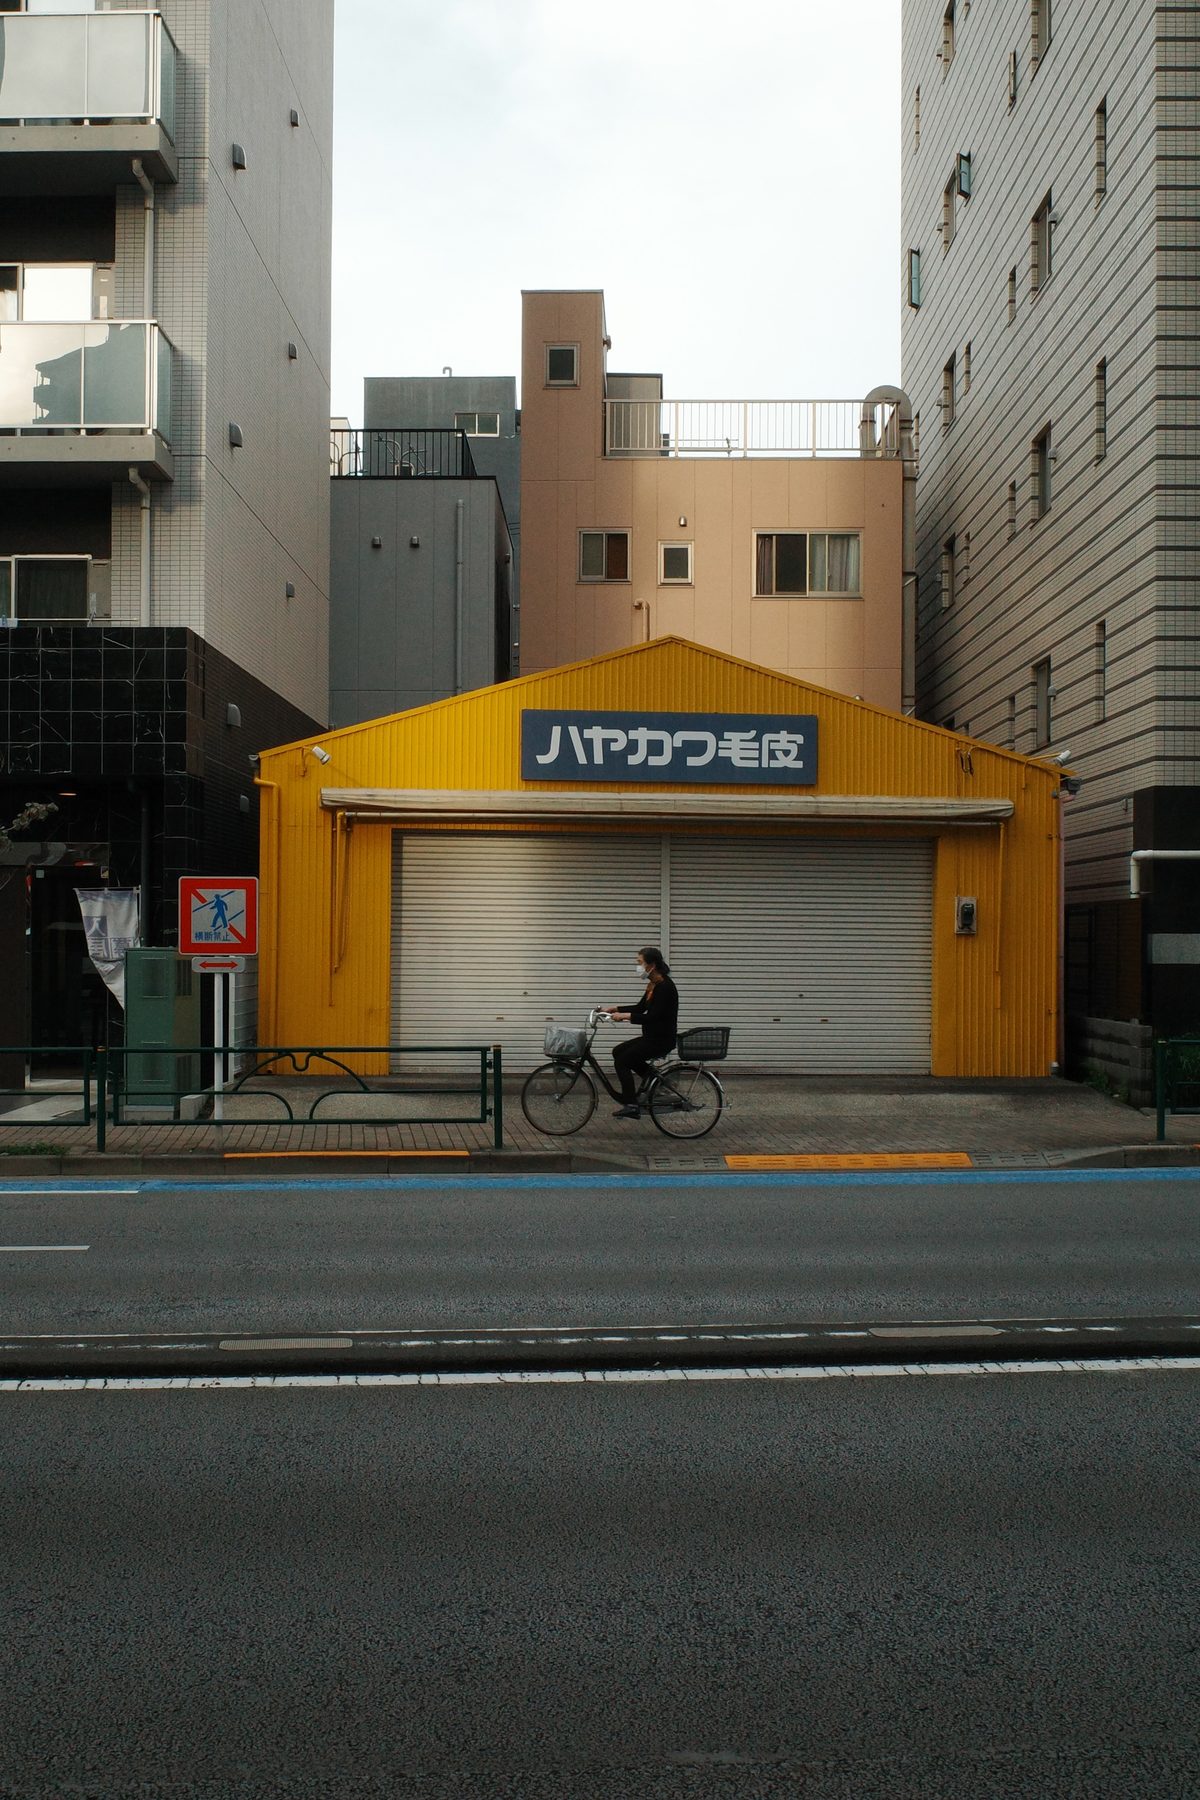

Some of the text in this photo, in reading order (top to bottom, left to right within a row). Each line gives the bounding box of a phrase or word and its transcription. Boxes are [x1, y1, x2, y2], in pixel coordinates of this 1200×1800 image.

[536, 725, 804, 768] ハヤカワ毛皮
[195, 931, 231, 941] 横断禁止
